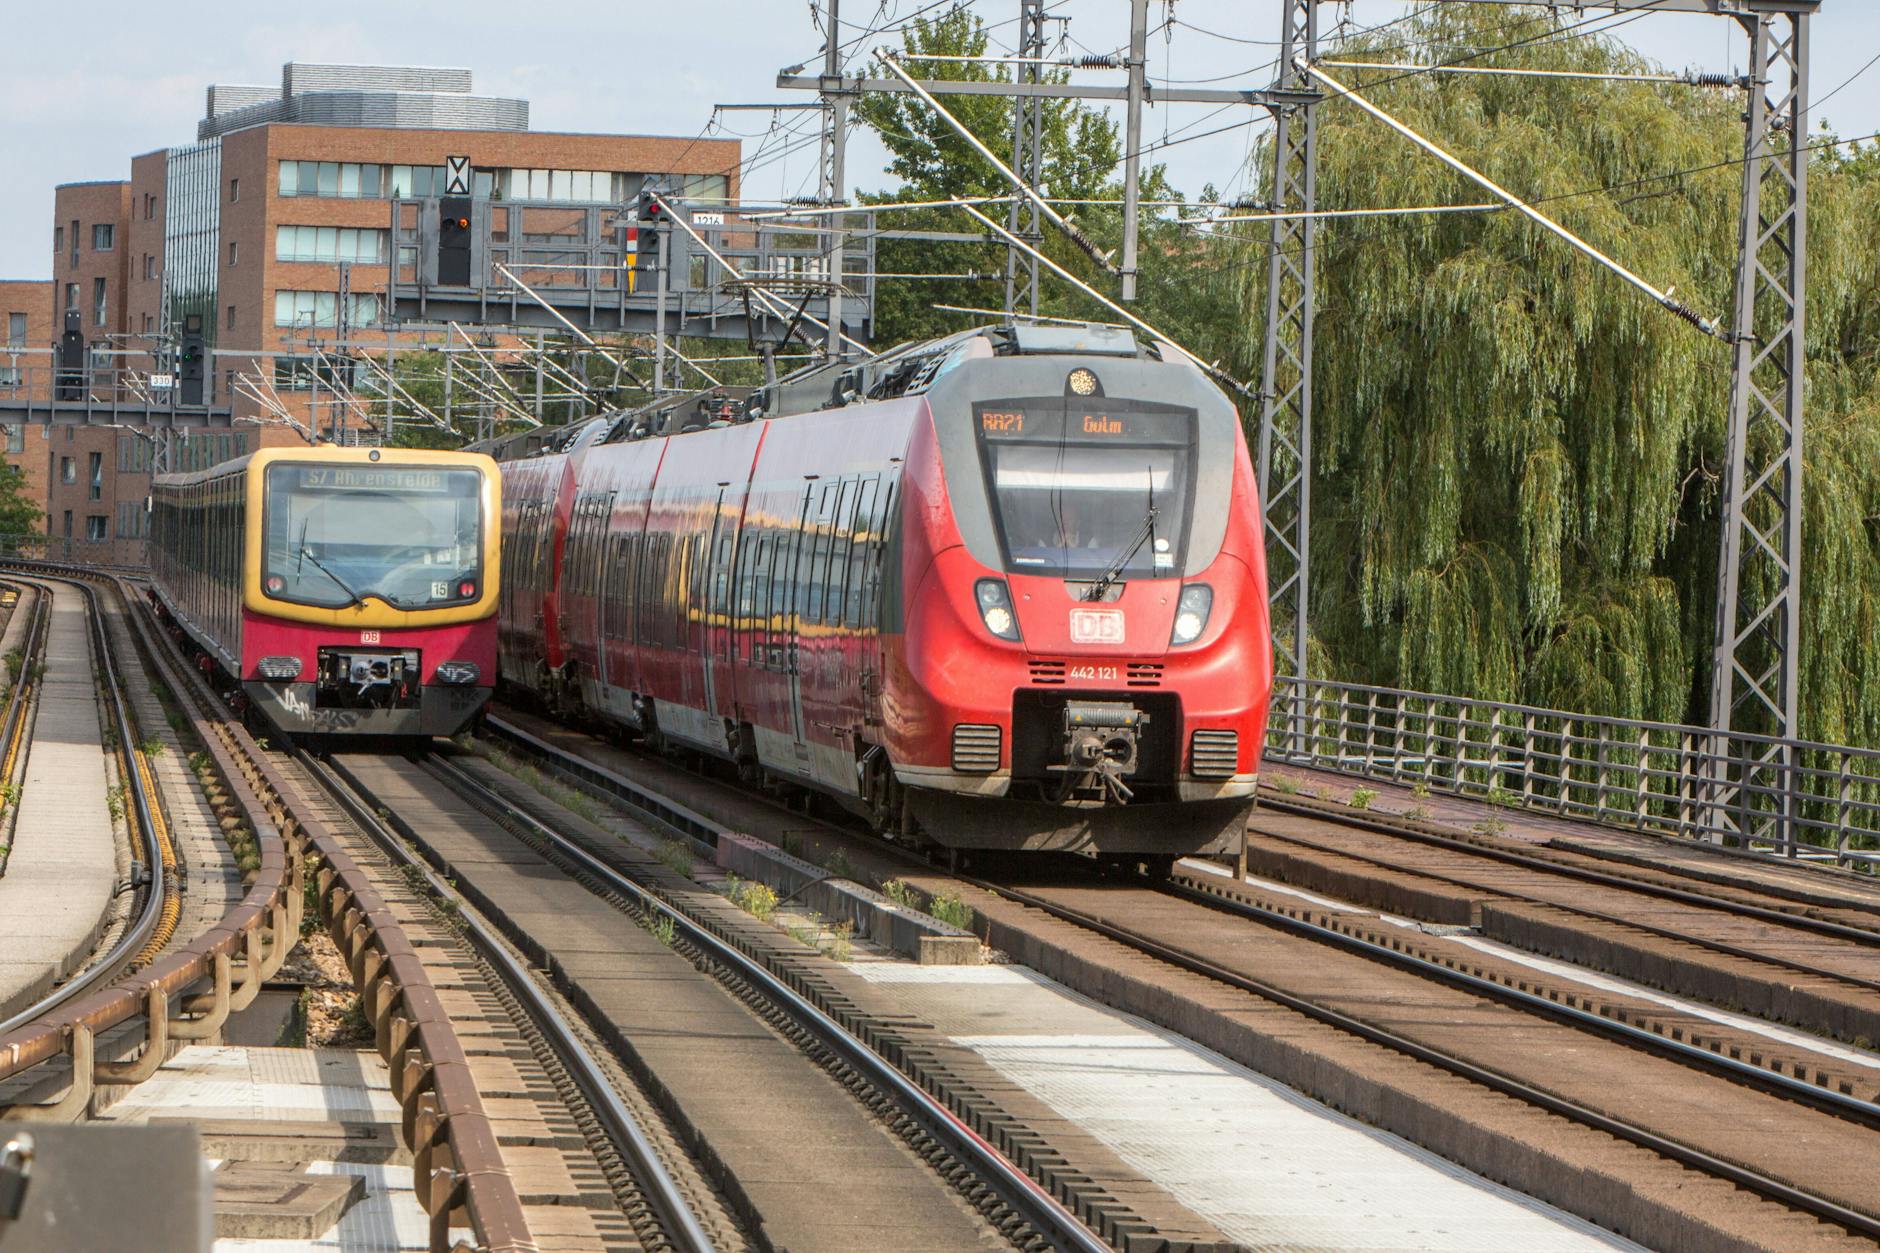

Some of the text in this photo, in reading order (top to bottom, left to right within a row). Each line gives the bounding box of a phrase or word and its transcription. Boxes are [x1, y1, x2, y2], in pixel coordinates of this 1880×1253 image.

[433, 583, 447, 596] 15
[1076, 613, 1120, 638] DB
[362, 632, 378, 642] DB
[1070, 666, 1117, 680] 442 121
